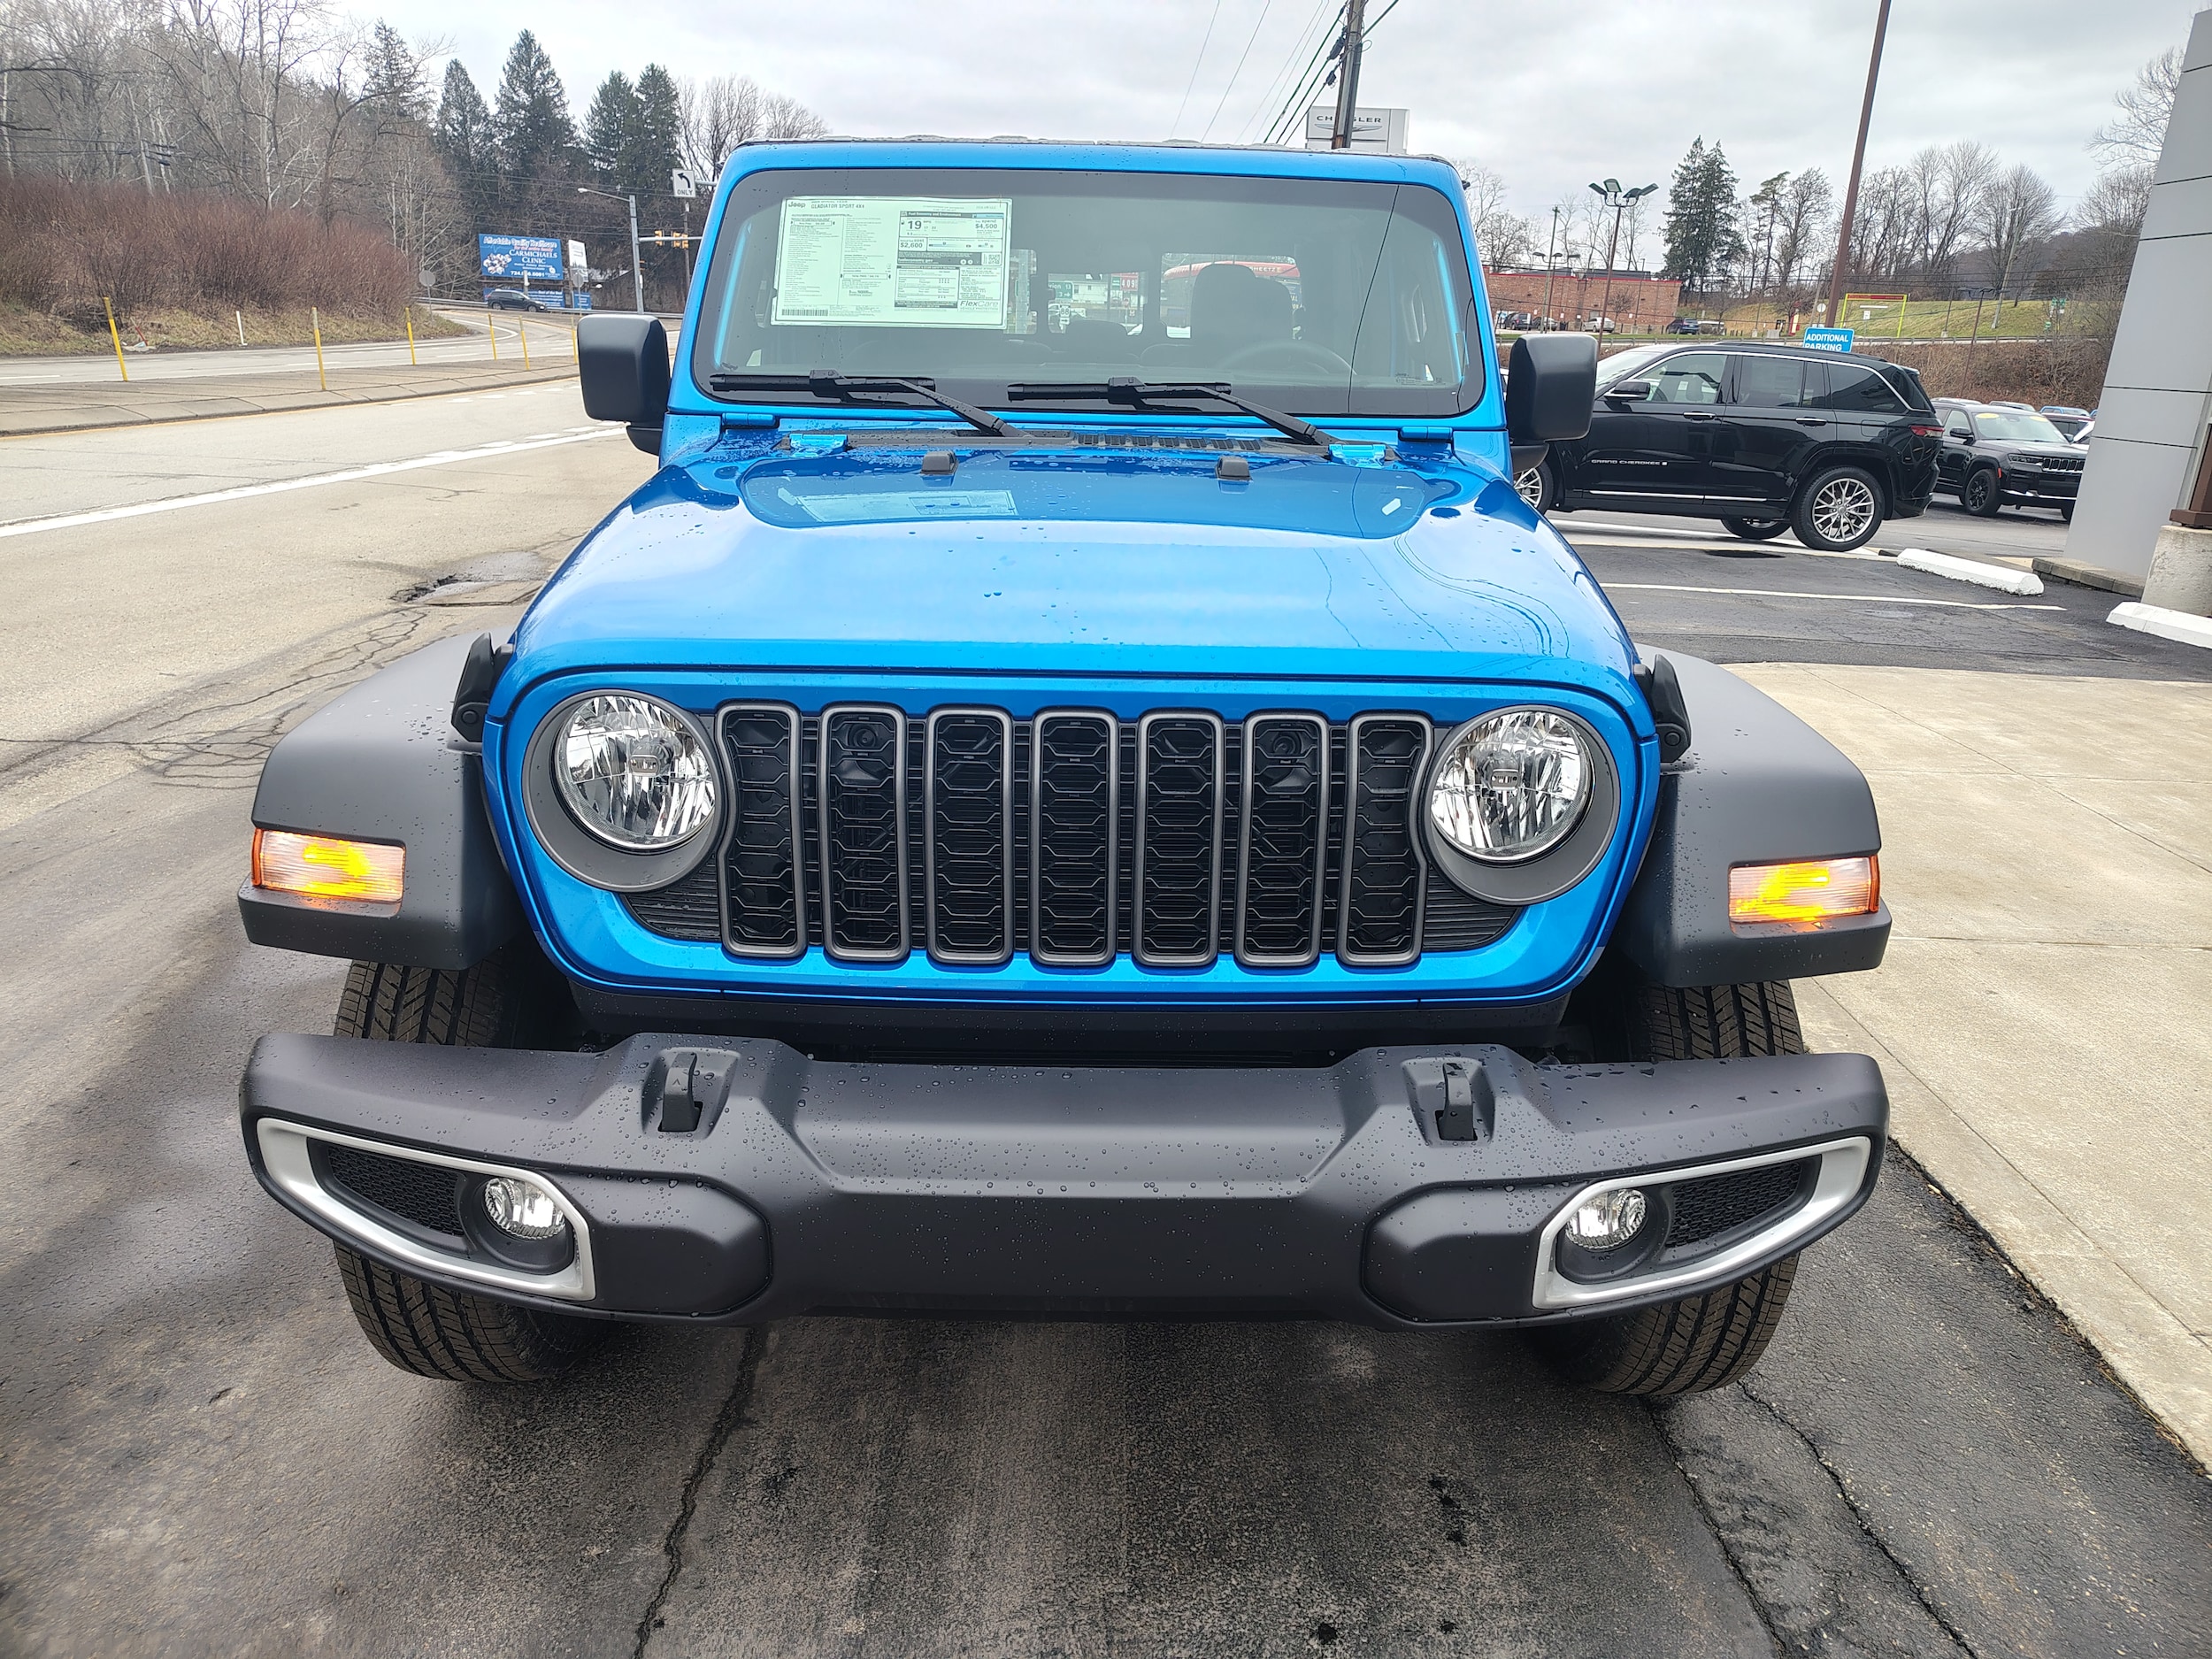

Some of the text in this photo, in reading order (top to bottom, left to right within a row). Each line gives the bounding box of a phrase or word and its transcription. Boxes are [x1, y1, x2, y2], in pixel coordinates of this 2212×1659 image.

[907, 220, 922, 229] 19
[509, 249, 558, 258] CARMICHAELS
[1806, 333, 1849, 342] ADDITIONAL
[1805, 343, 1842, 351] PARKING
